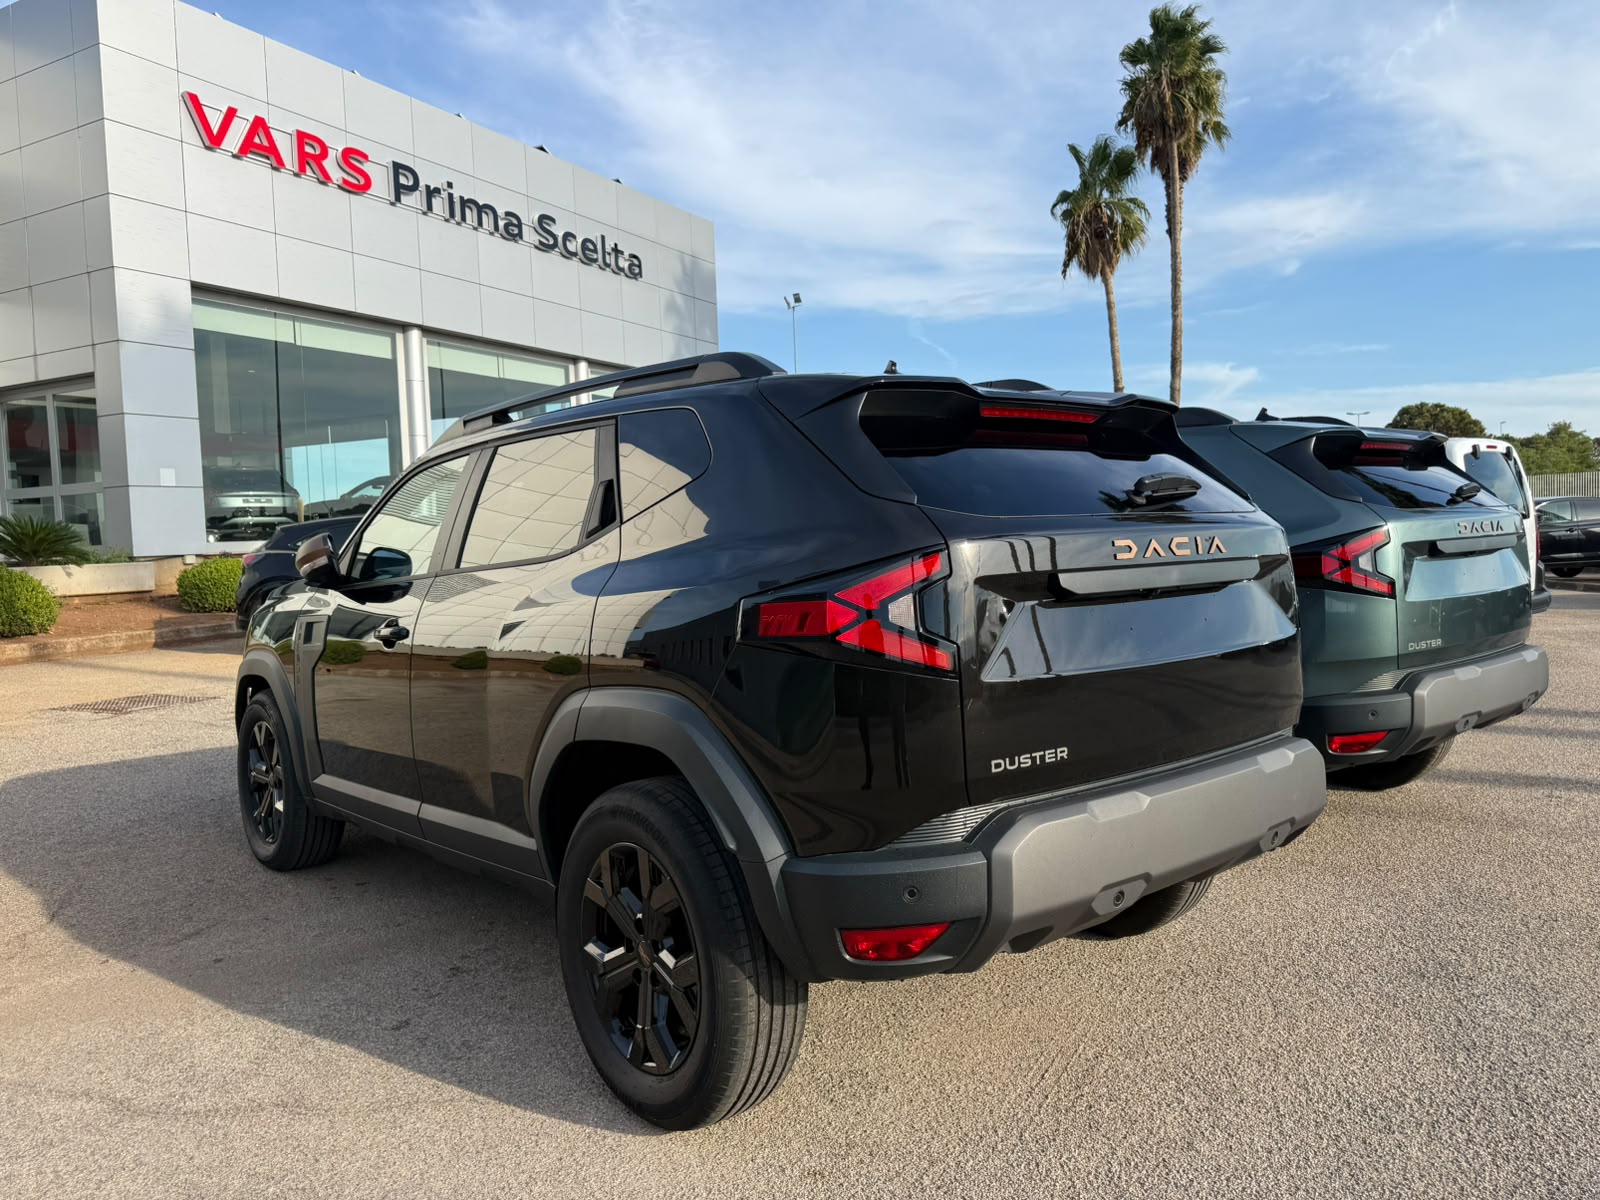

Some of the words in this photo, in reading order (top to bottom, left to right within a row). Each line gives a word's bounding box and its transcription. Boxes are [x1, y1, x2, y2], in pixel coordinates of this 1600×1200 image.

[182, 91, 373, 192] VARS
[389, 160, 523, 242] Prima
[533, 213, 643, 279] Scelta
[1457, 520, 1504, 535] DACIA
[1112, 536, 1227, 560] DACIA
[1408, 638, 1442, 651] DUSTER
[990, 747, 1068, 773] DUSTER
